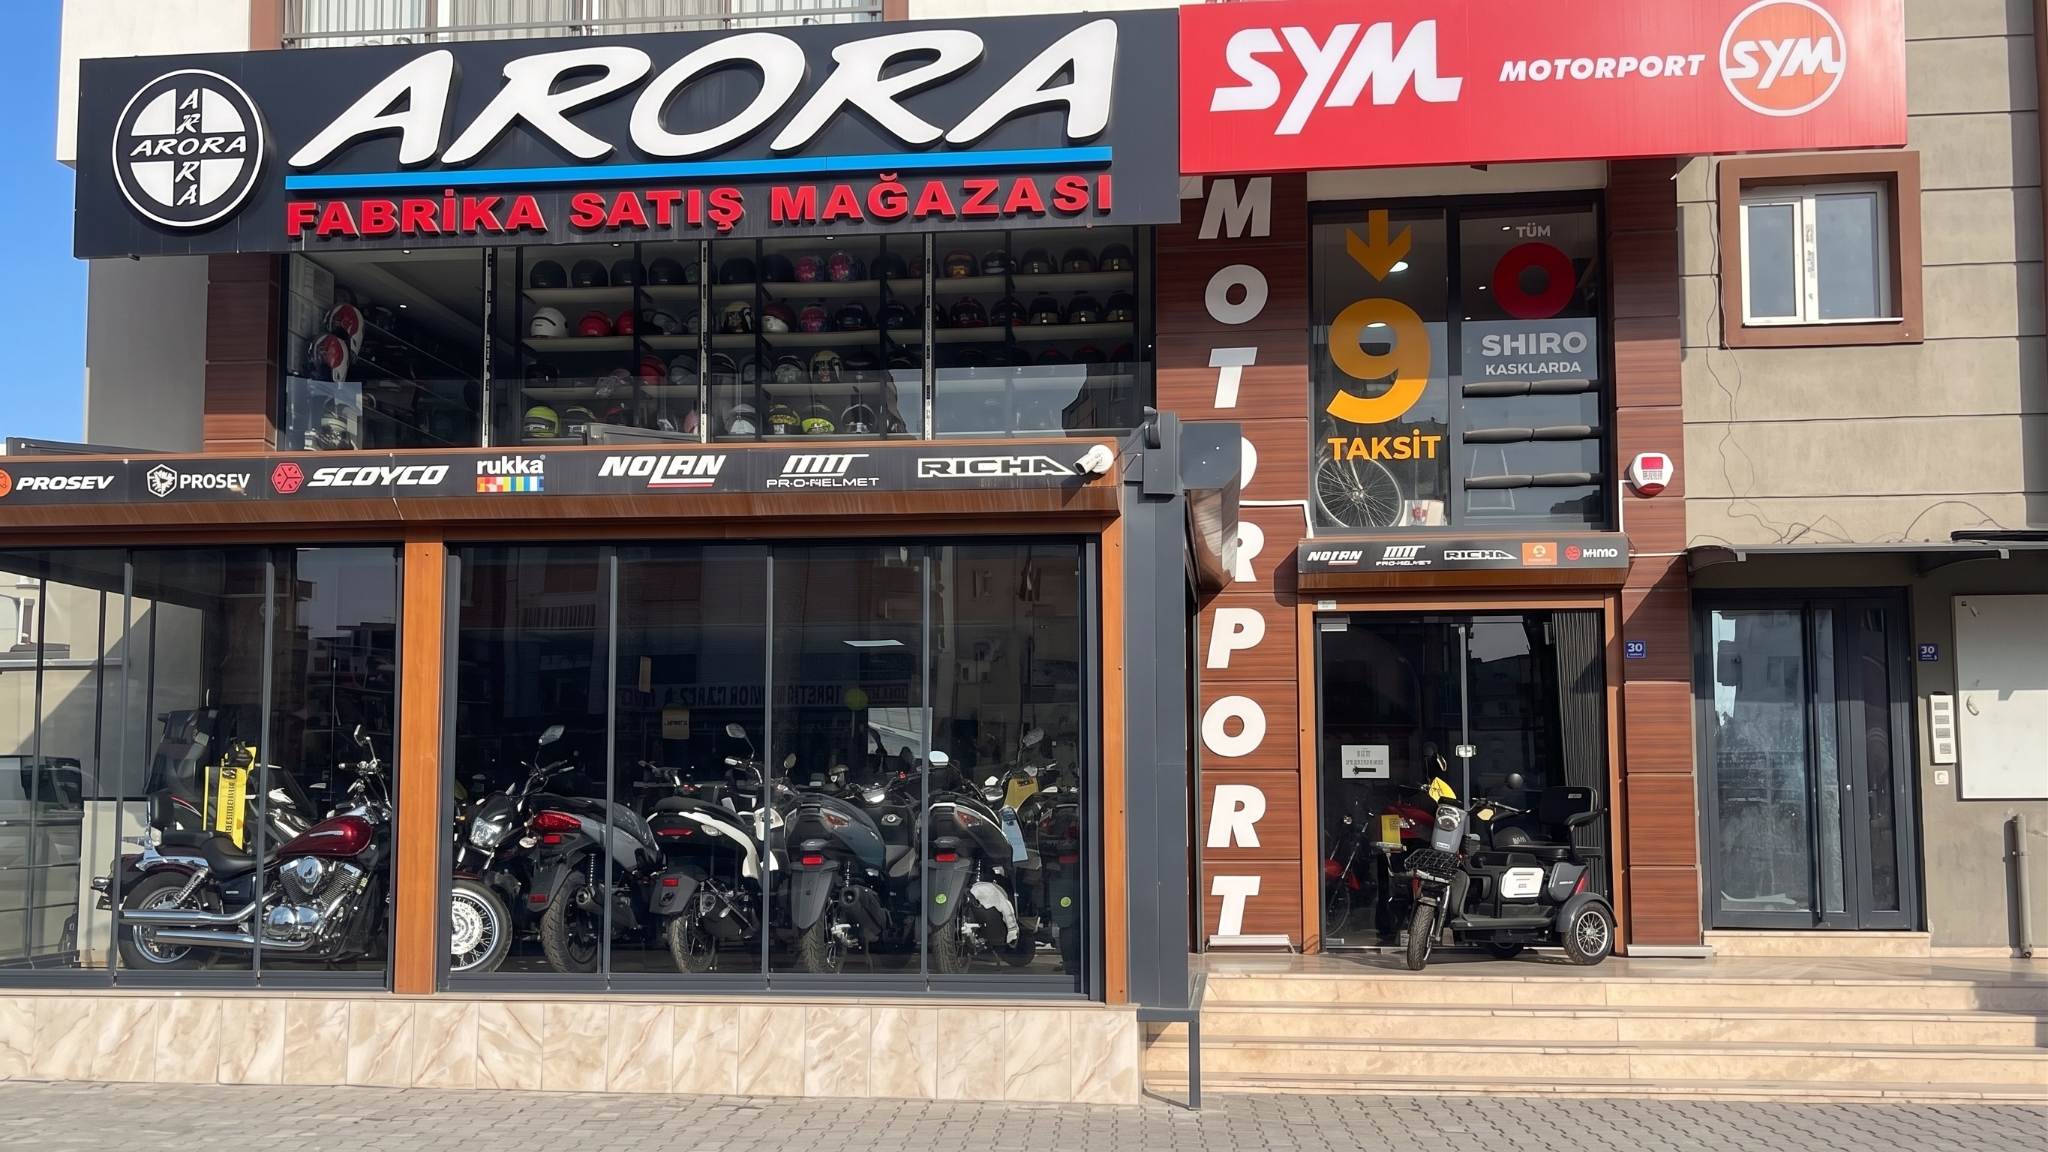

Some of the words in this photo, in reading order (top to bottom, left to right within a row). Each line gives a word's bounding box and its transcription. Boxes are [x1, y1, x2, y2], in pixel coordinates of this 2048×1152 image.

[1499, 54, 1705, 82] MOTORPORT
[1726, 36, 1841, 90] SYM
[1209, 19, 1463, 136] SYM
[287, 18, 1119, 167] ARORA
[130, 136, 247, 157] ARORA
[286, 189, 548, 238] FABRİKA
[569, 185, 744, 232] SATIŞ
[770, 173, 1112, 222] MAĞAZASI
[1516, 222, 1551, 238] TÜM
[1481, 331, 1588, 357] SHIRO
[1326, 298, 1431, 424] 9
[1485, 361, 1582, 376] KASKLARDA
[1327, 428, 1442, 461] TAKSİT
[307, 465, 450, 487] SCOYCO
[476, 455, 544, 475] rukka
[597, 455, 727, 485] NOLAN
[918, 456, 1079, 478] RICHA
[15, 475, 115, 491] PROSEV
[180, 473, 251, 490] PROSEV
[1307, 550, 1363, 565] NOLAN
[1443, 550, 1518, 560] RICHA
[1627, 643, 1643, 652] 30
[1920, 646, 1935, 654] 30
